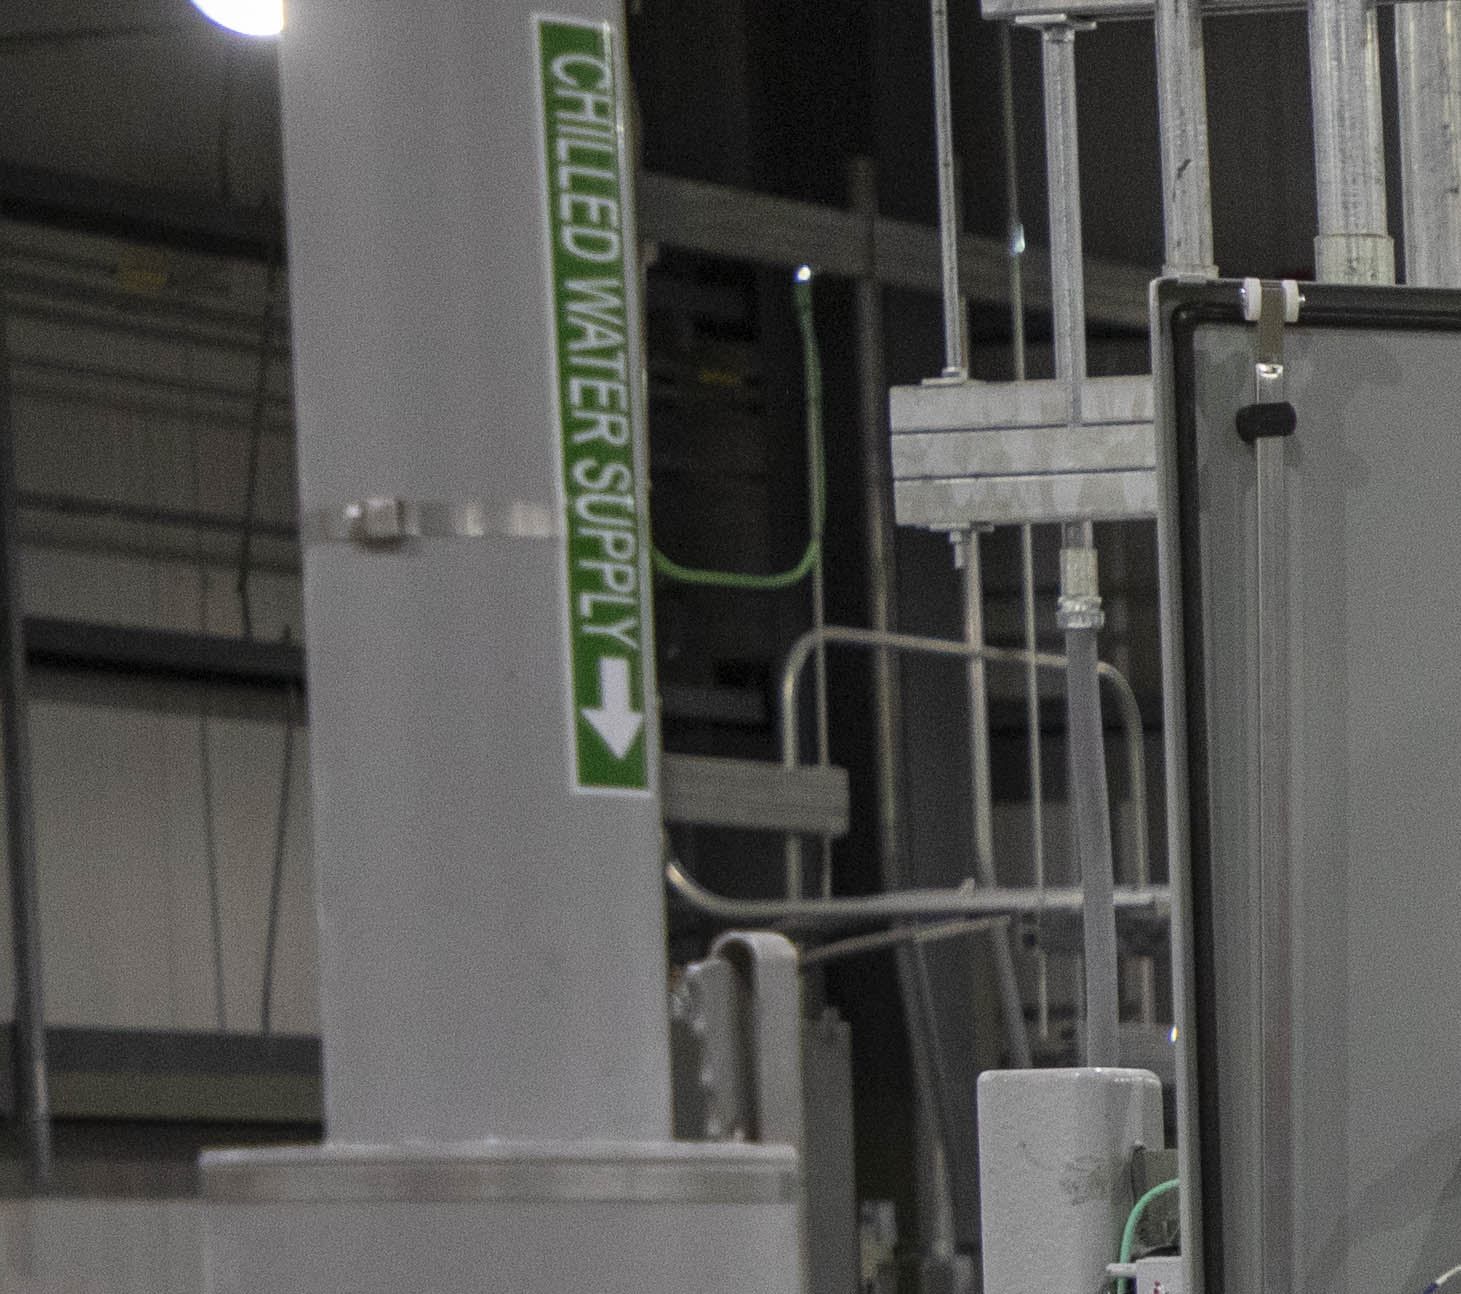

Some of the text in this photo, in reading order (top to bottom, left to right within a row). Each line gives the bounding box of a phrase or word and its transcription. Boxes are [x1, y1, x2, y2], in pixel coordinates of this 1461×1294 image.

[549, 56, 642, 649] CHILLED WATER SUPPLY
